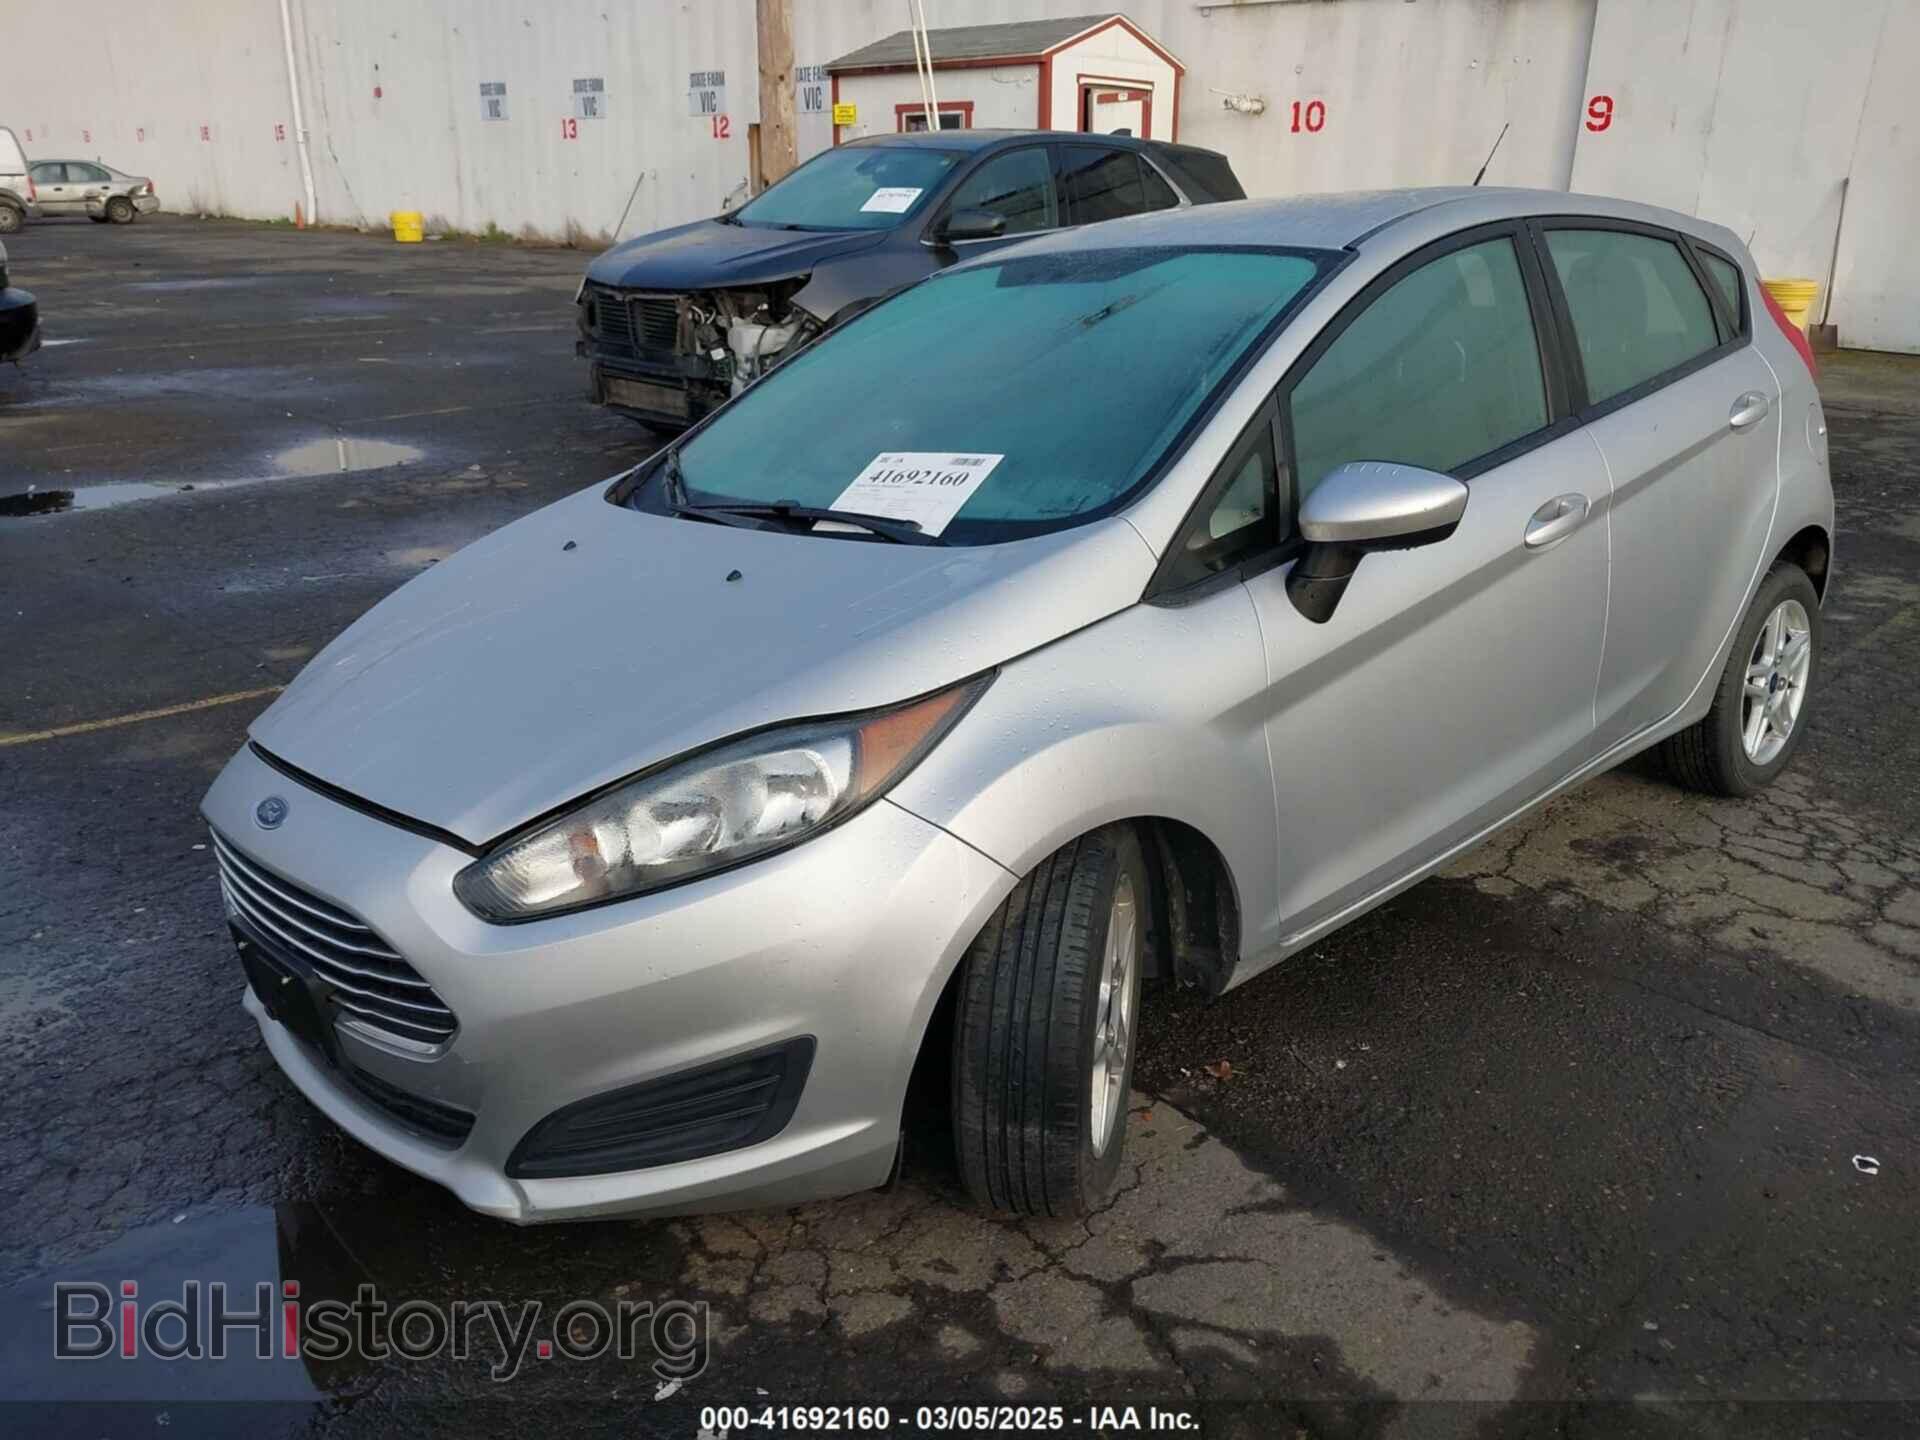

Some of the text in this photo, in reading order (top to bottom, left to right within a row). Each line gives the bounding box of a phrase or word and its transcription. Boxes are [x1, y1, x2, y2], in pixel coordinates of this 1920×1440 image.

[690, 71, 725, 88] STATE FARM
[582, 96, 598, 116] VIC
[700, 91, 717, 113] VIC
[803, 86, 822, 110] VIC
[1291, 101, 1326, 133] 10
[1585, 95, 1614, 132] 9
[562, 118, 577, 139] 13
[712, 116, 730, 138] 12
[869, 469, 970, 487] 41692160
